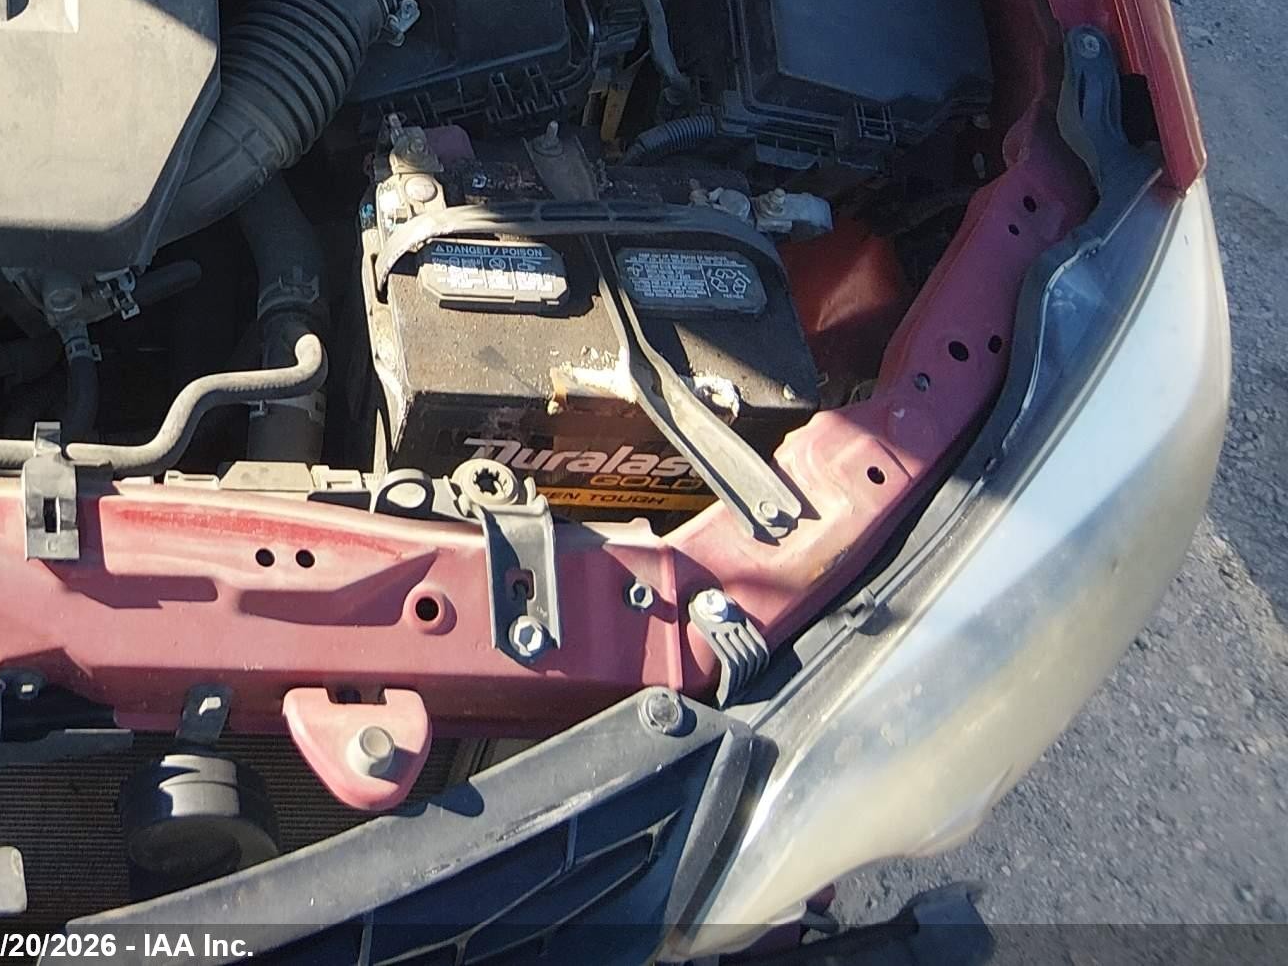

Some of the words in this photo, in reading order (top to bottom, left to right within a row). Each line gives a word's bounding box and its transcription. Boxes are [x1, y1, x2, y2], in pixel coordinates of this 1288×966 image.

[445, 244, 490, 255] DANGER
[502, 247, 543, 257] POISON
[463, 437, 698, 477] Duralas
[589, 474, 704, 491] GOLD
[589, 493, 667, 505] TOUGH
